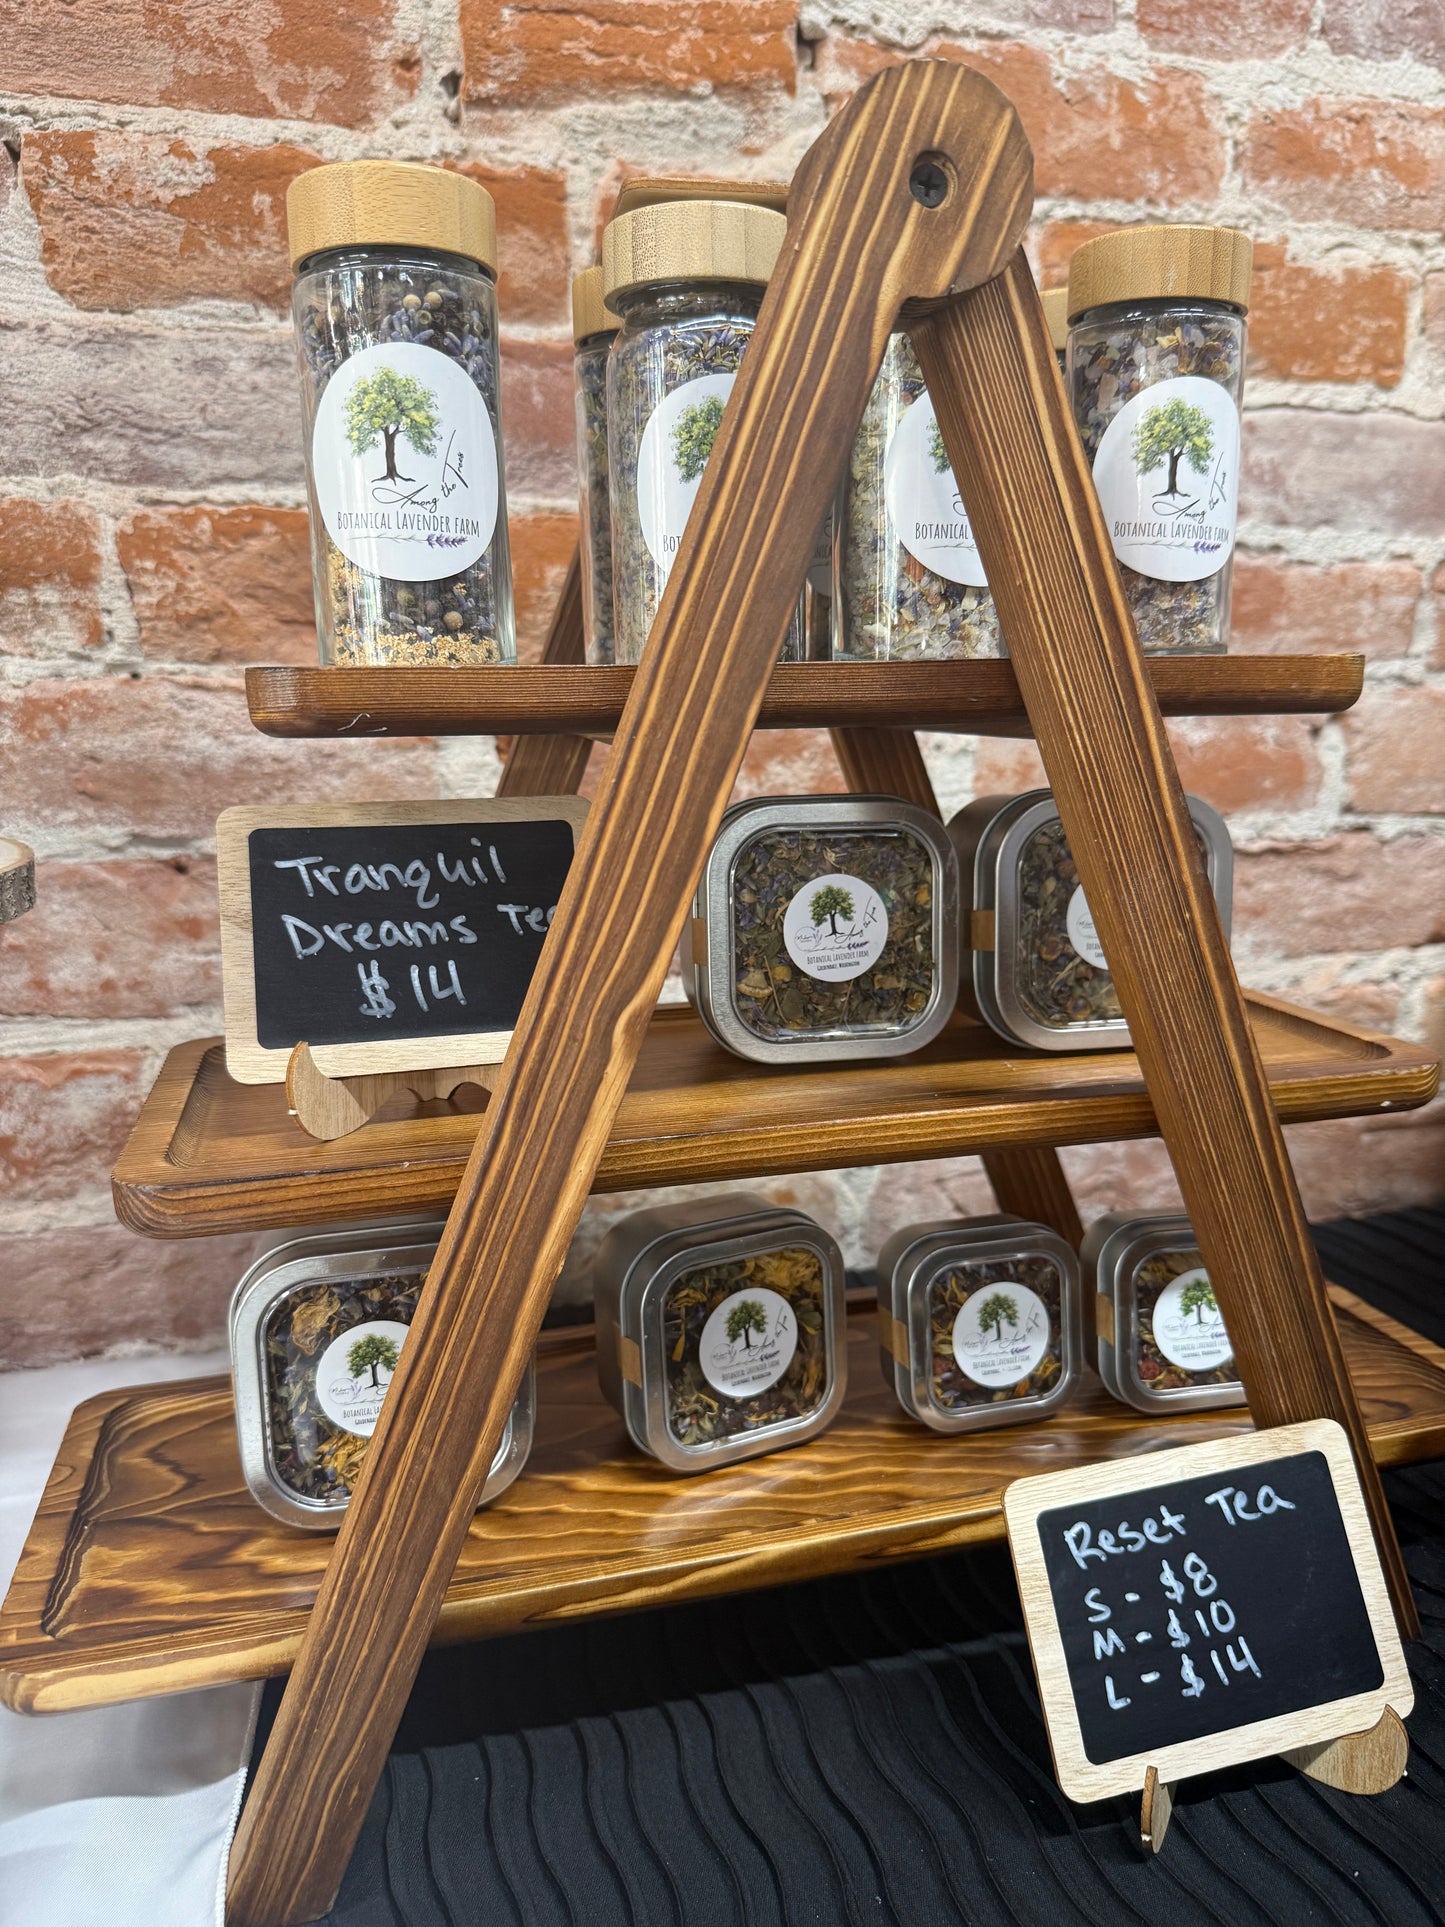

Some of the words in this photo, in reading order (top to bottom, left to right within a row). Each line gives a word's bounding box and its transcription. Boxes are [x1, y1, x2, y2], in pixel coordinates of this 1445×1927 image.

[337, 511, 392, 530] BOTANICAL
[396, 510, 451, 533] LAVENDER
[455, 517, 480, 538] FARM
[915, 522, 968, 540] BOTANICAL
[1113, 520, 1167, 538] BOTANICAL
[1171, 520, 1212, 541] LAVENDER
[274, 837, 507, 909] Tranquil
[281, 914, 478, 960] Dreams
[1063, 1505, 1188, 1570] Reset
[1204, 1484, 1297, 1526] Tea
[1084, 1588, 1112, 1622] S
[1159, 1551, 1218, 1604] $8
[1092, 1628, 1126, 1660] M
[1167, 1599, 1236, 1648] $10
[1105, 1675, 1131, 1710] L
[1181, 1636, 1262, 1698] $14
